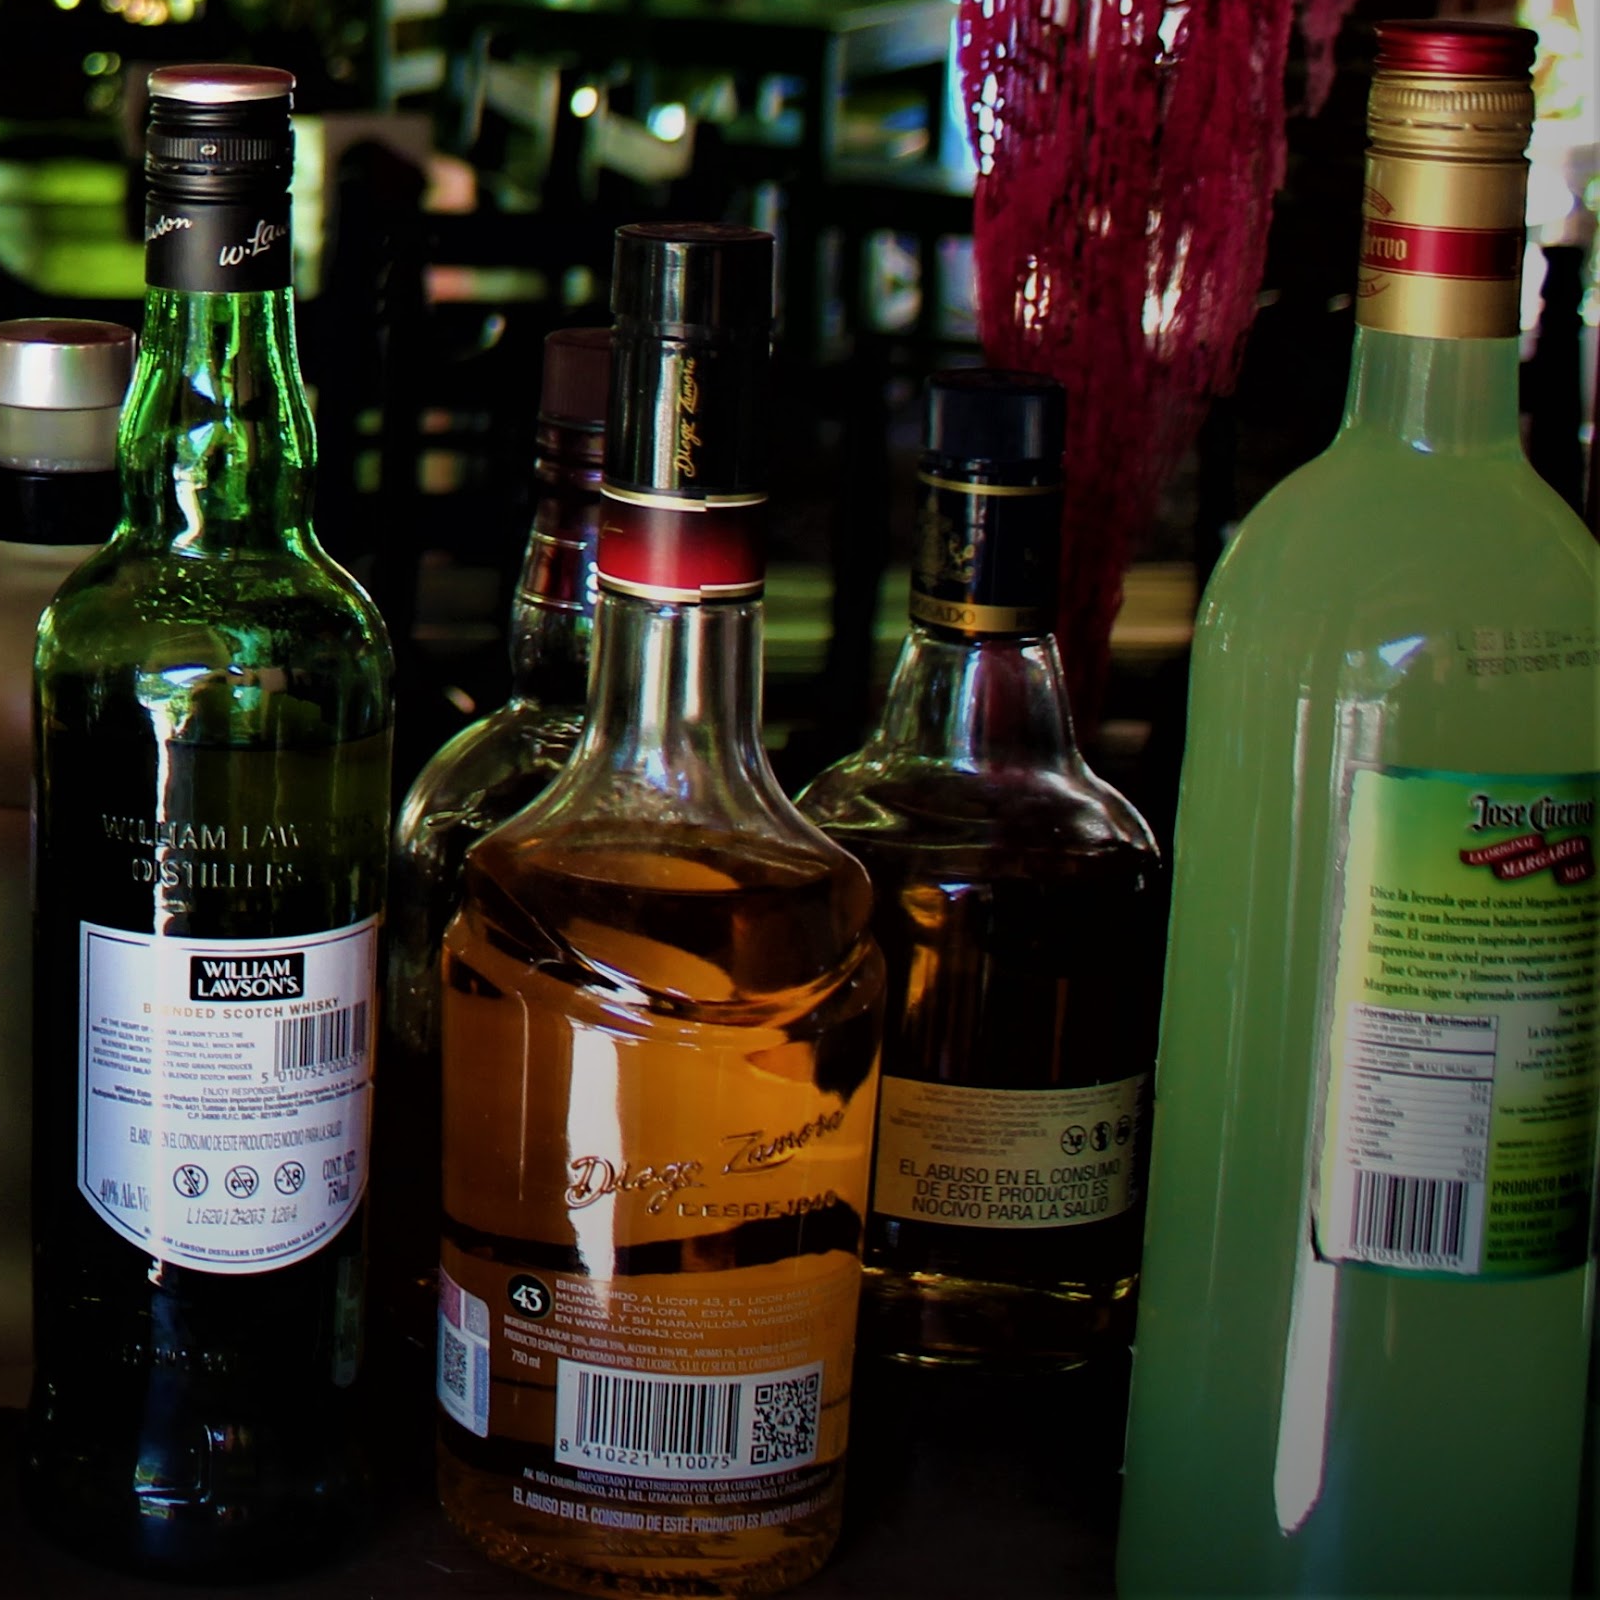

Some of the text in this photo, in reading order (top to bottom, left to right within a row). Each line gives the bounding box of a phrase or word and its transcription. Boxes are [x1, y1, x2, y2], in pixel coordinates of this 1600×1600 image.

[1470, 794, 1527, 832] Jose
[196, 958, 301, 1000] WILLIAM LAWSON'S
[222, 997, 341, 1020] SCOTCH WHISKY
[898, 1157, 1122, 1186] EL ABUSO EN EL CONSUMO
[916, 1178, 1109, 1204] DE ESTE PRODUCTO ES
[911, 1195, 1109, 1221] NOCIVO PARA LA SALUD
[511, 1284, 544, 1313] 43
[622, 1301, 688, 1319] EXPLORA
[655, 1290, 700, 1307] LICOR
[559, 1437, 730, 1470] 8 410221 110075
[590, 1505, 645, 1531] CONSUMO
